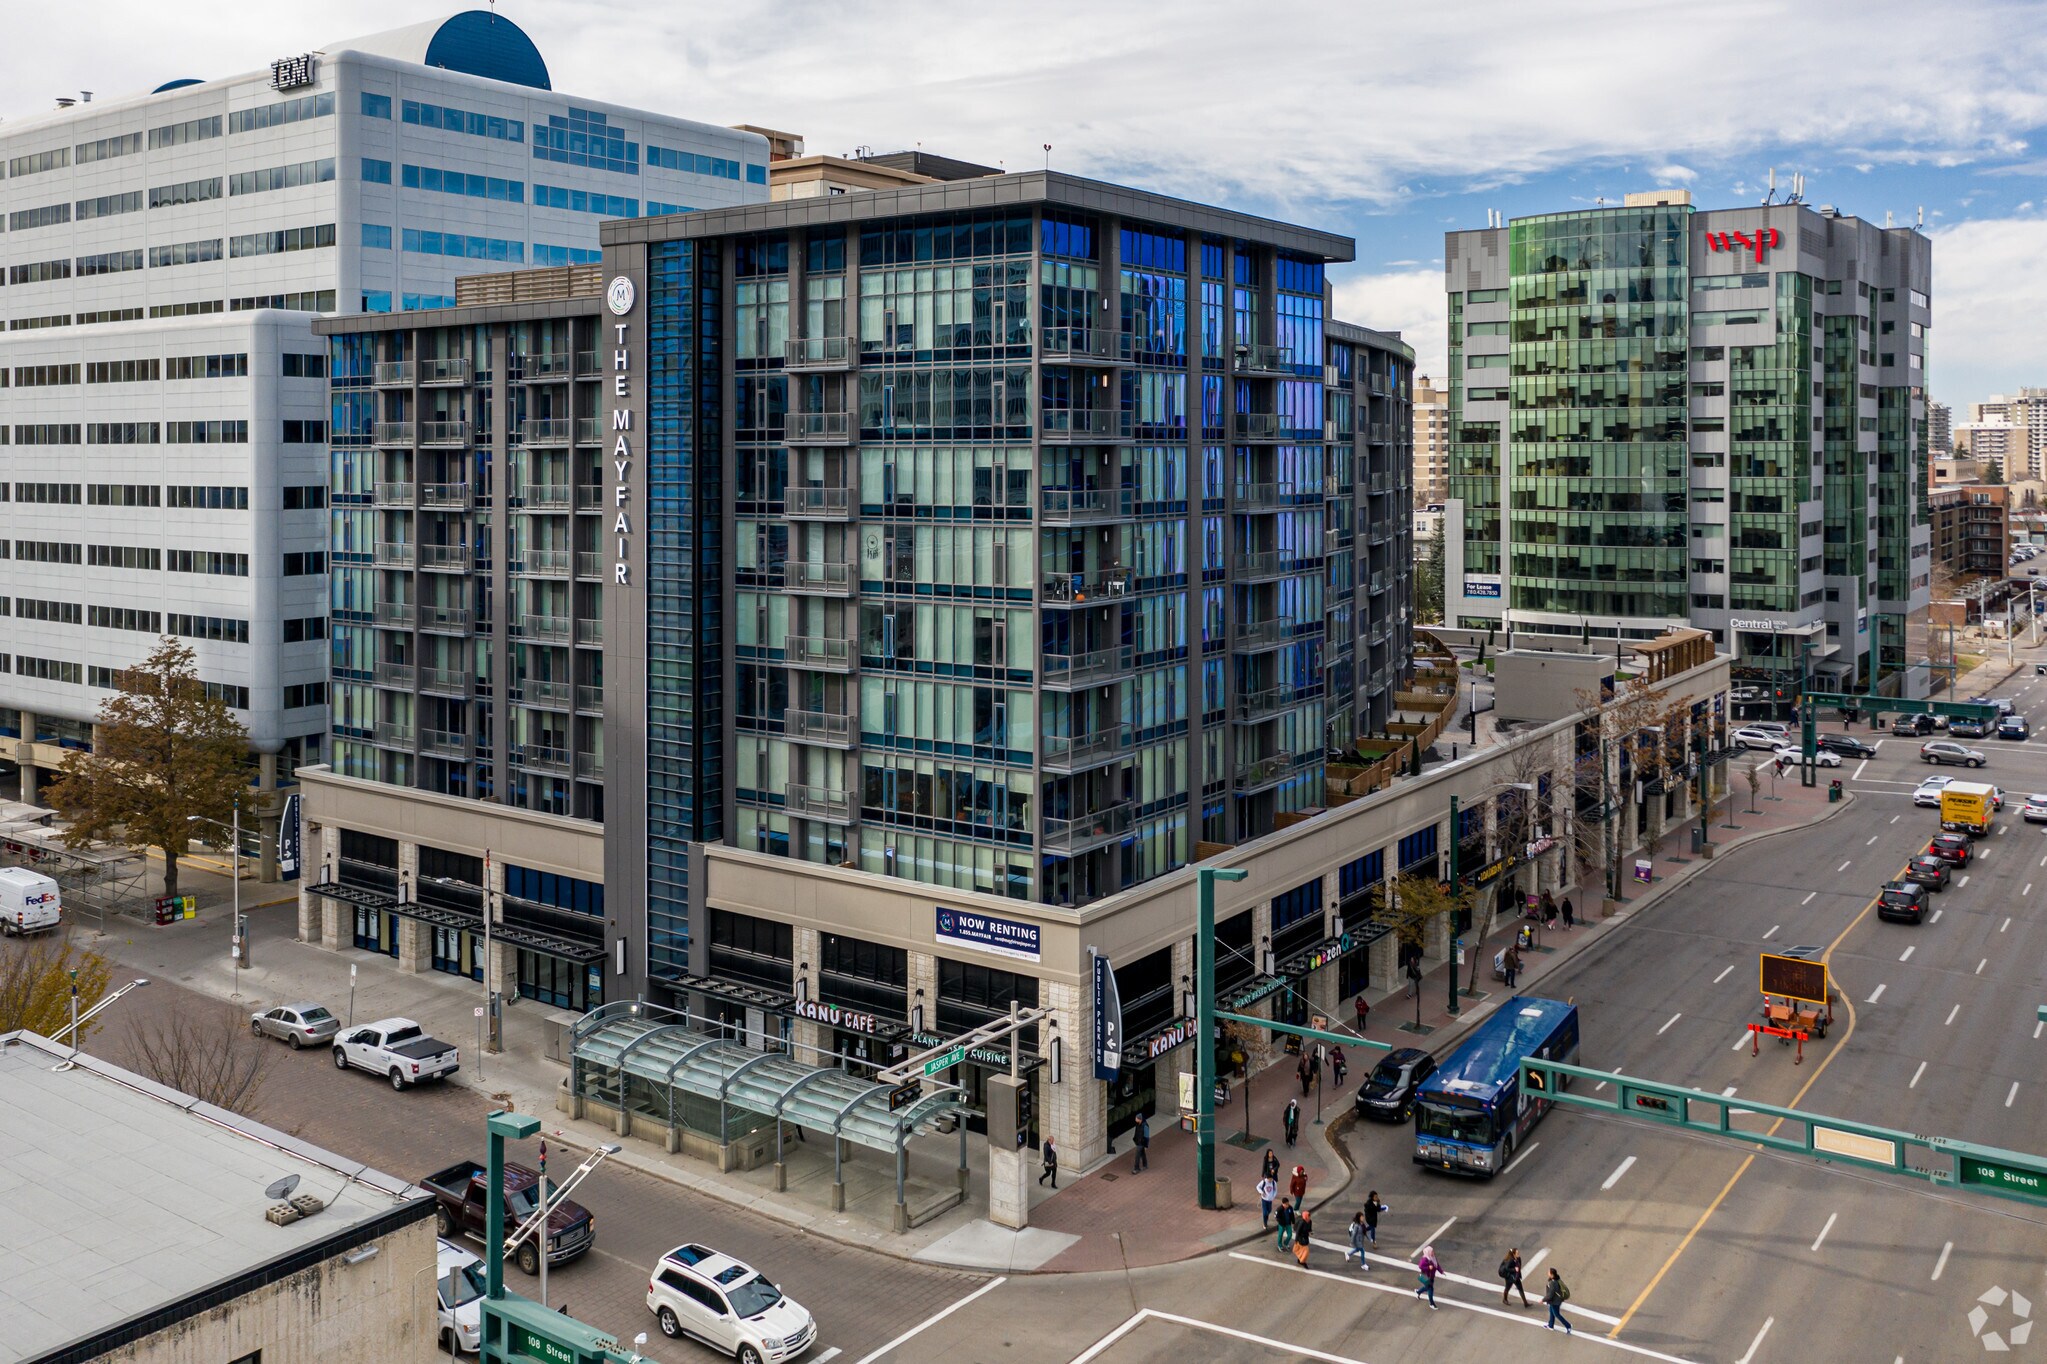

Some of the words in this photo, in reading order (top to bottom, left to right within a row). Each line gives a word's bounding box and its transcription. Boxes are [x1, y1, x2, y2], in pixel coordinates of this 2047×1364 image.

[271, 54, 309, 90] IBM
[1706, 228, 1778, 264] wsp
[616, 289, 626, 301] M
[614, 323, 627, 396] THE
[613, 409, 630, 584] MAYFAIR
[1730, 618, 1772, 629] Central
[284, 838, 291, 850] P
[26, 893, 56, 906] FedEx
[959, 916, 985, 930] NOW
[989, 922, 1037, 941] RENTING
[959, 928, 992, 940] 1.855.MAYFAIR
[795, 1000, 841, 1024] KANU
[845, 1012, 874, 1033] CAFÉ
[1107, 1021, 1115, 1036] P
[912, 1033, 939, 1048] PLANT
[971, 1048, 1007, 1065] CUISINE
[1150, 1025, 1184, 1058] KANU
[930, 1056, 949, 1072] JASPER
[950, 1051, 960, 1063] AVE
[1976, 1167, 1995, 1178] 108
[2003, 1171, 2038, 1187] Street
[528, 1335, 541, 1349] 108
[546, 1344, 571, 1363] Street
